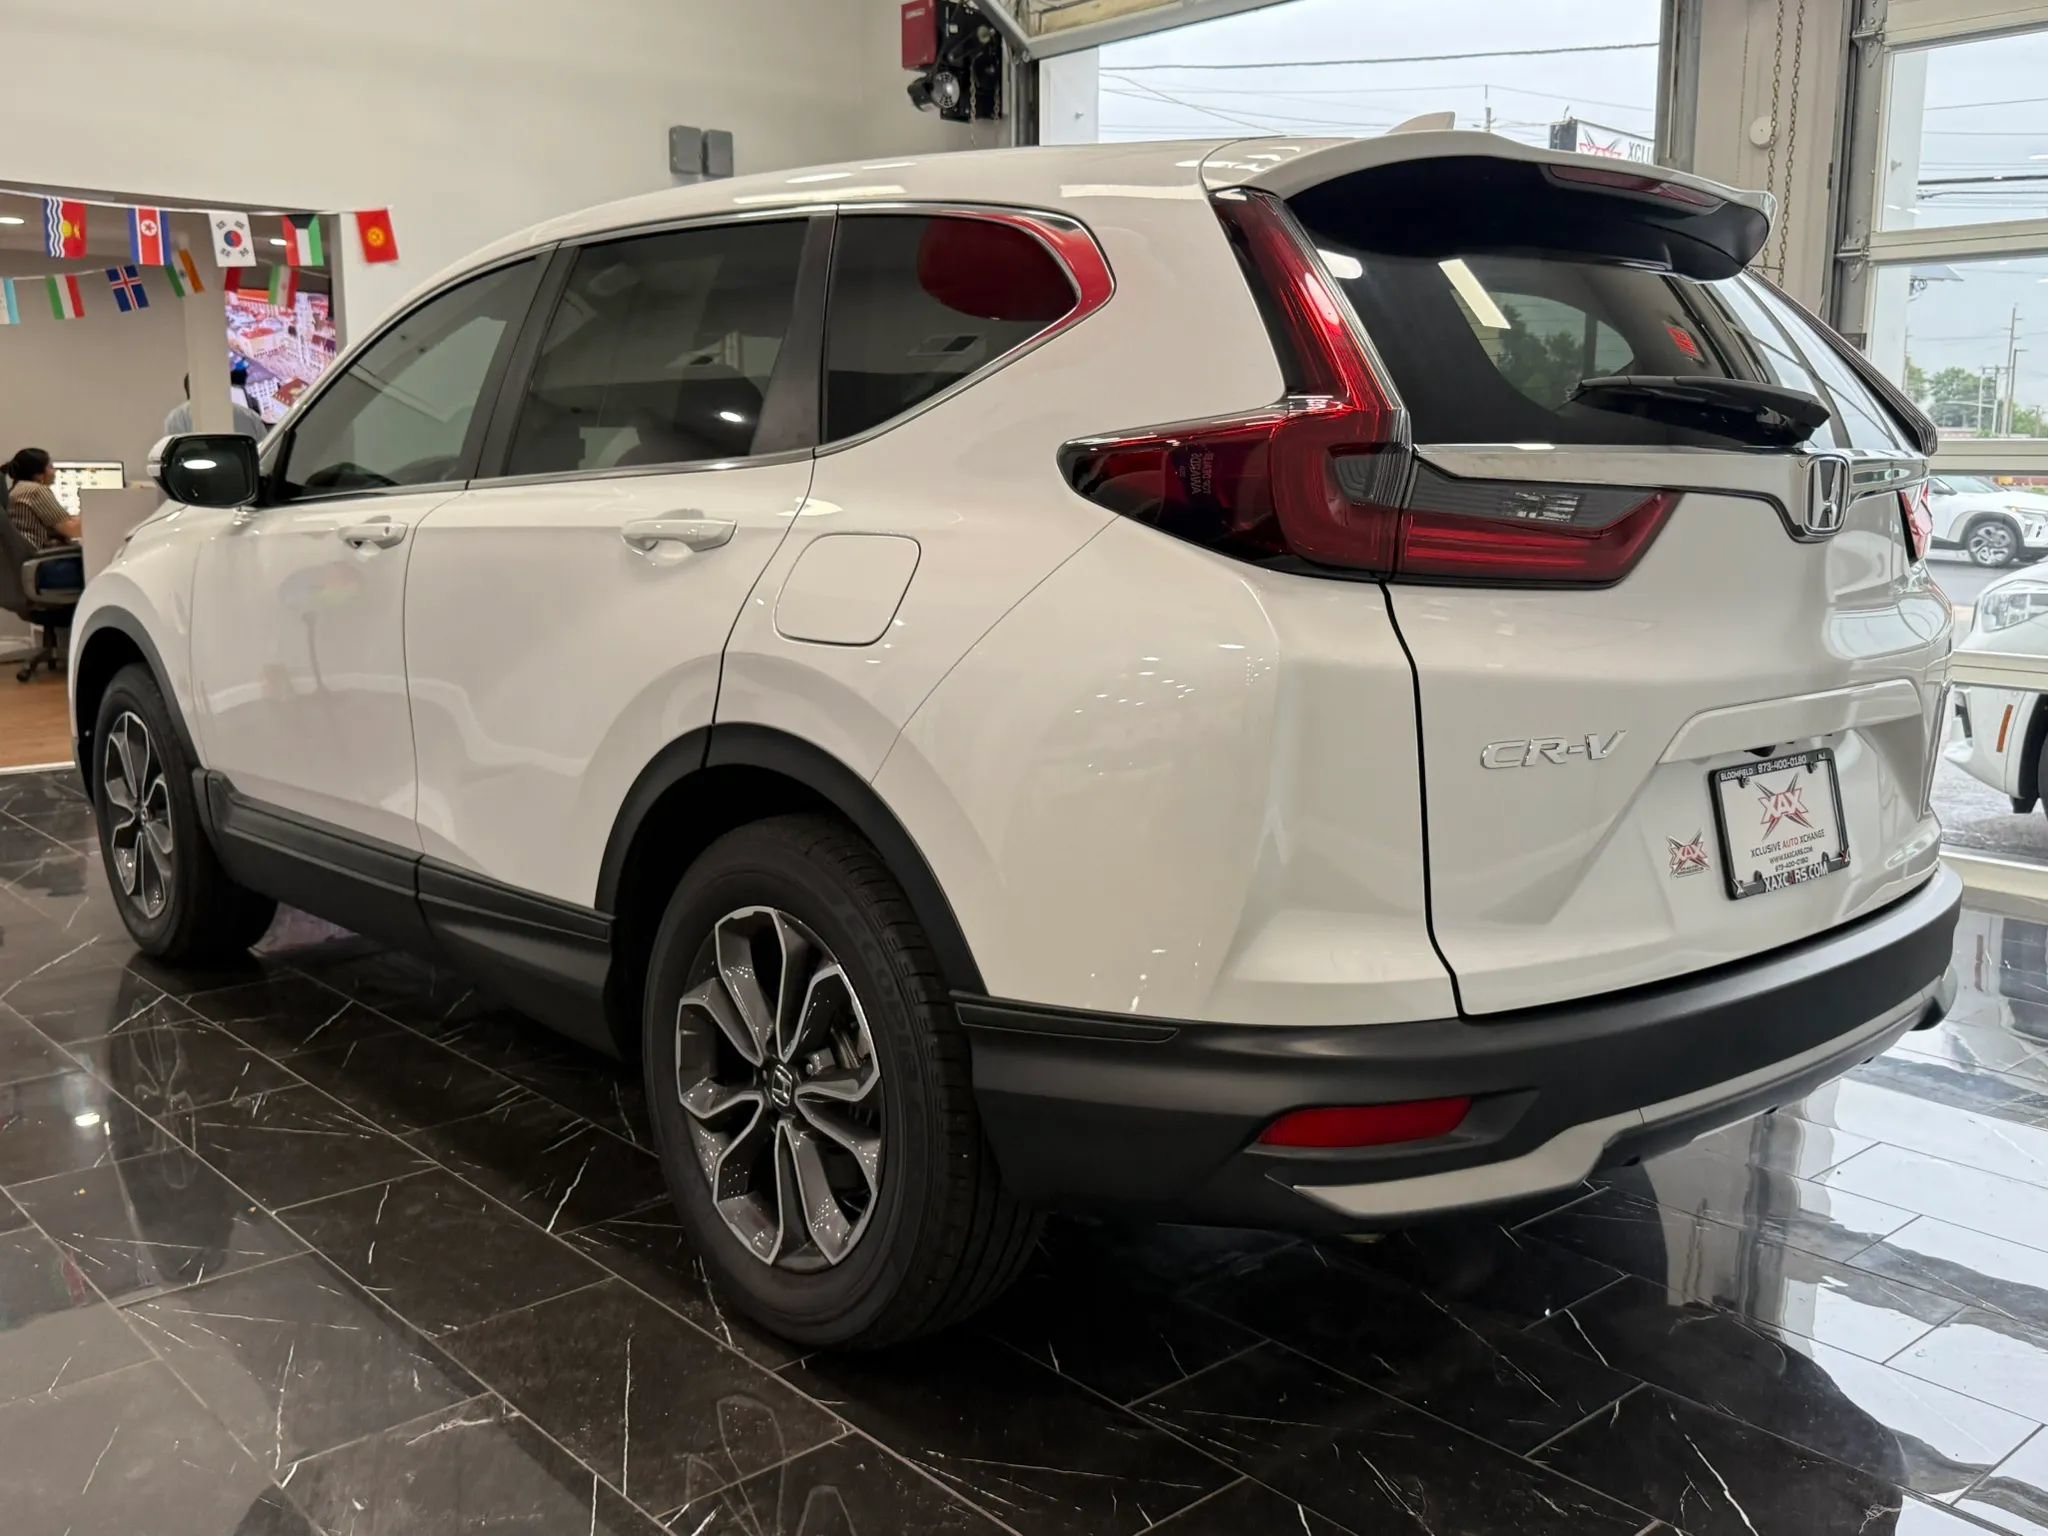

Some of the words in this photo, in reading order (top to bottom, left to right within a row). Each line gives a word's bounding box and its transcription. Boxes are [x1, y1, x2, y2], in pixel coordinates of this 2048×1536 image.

[1480, 729, 1627, 769] CR-V
[1750, 841, 1781, 858] XCLUSIVE
[1782, 836, 1799, 849] AUTO
[1799, 828, 1825, 844] XCHANGE
[1763, 862, 1829, 893] XAXCARS.COM
